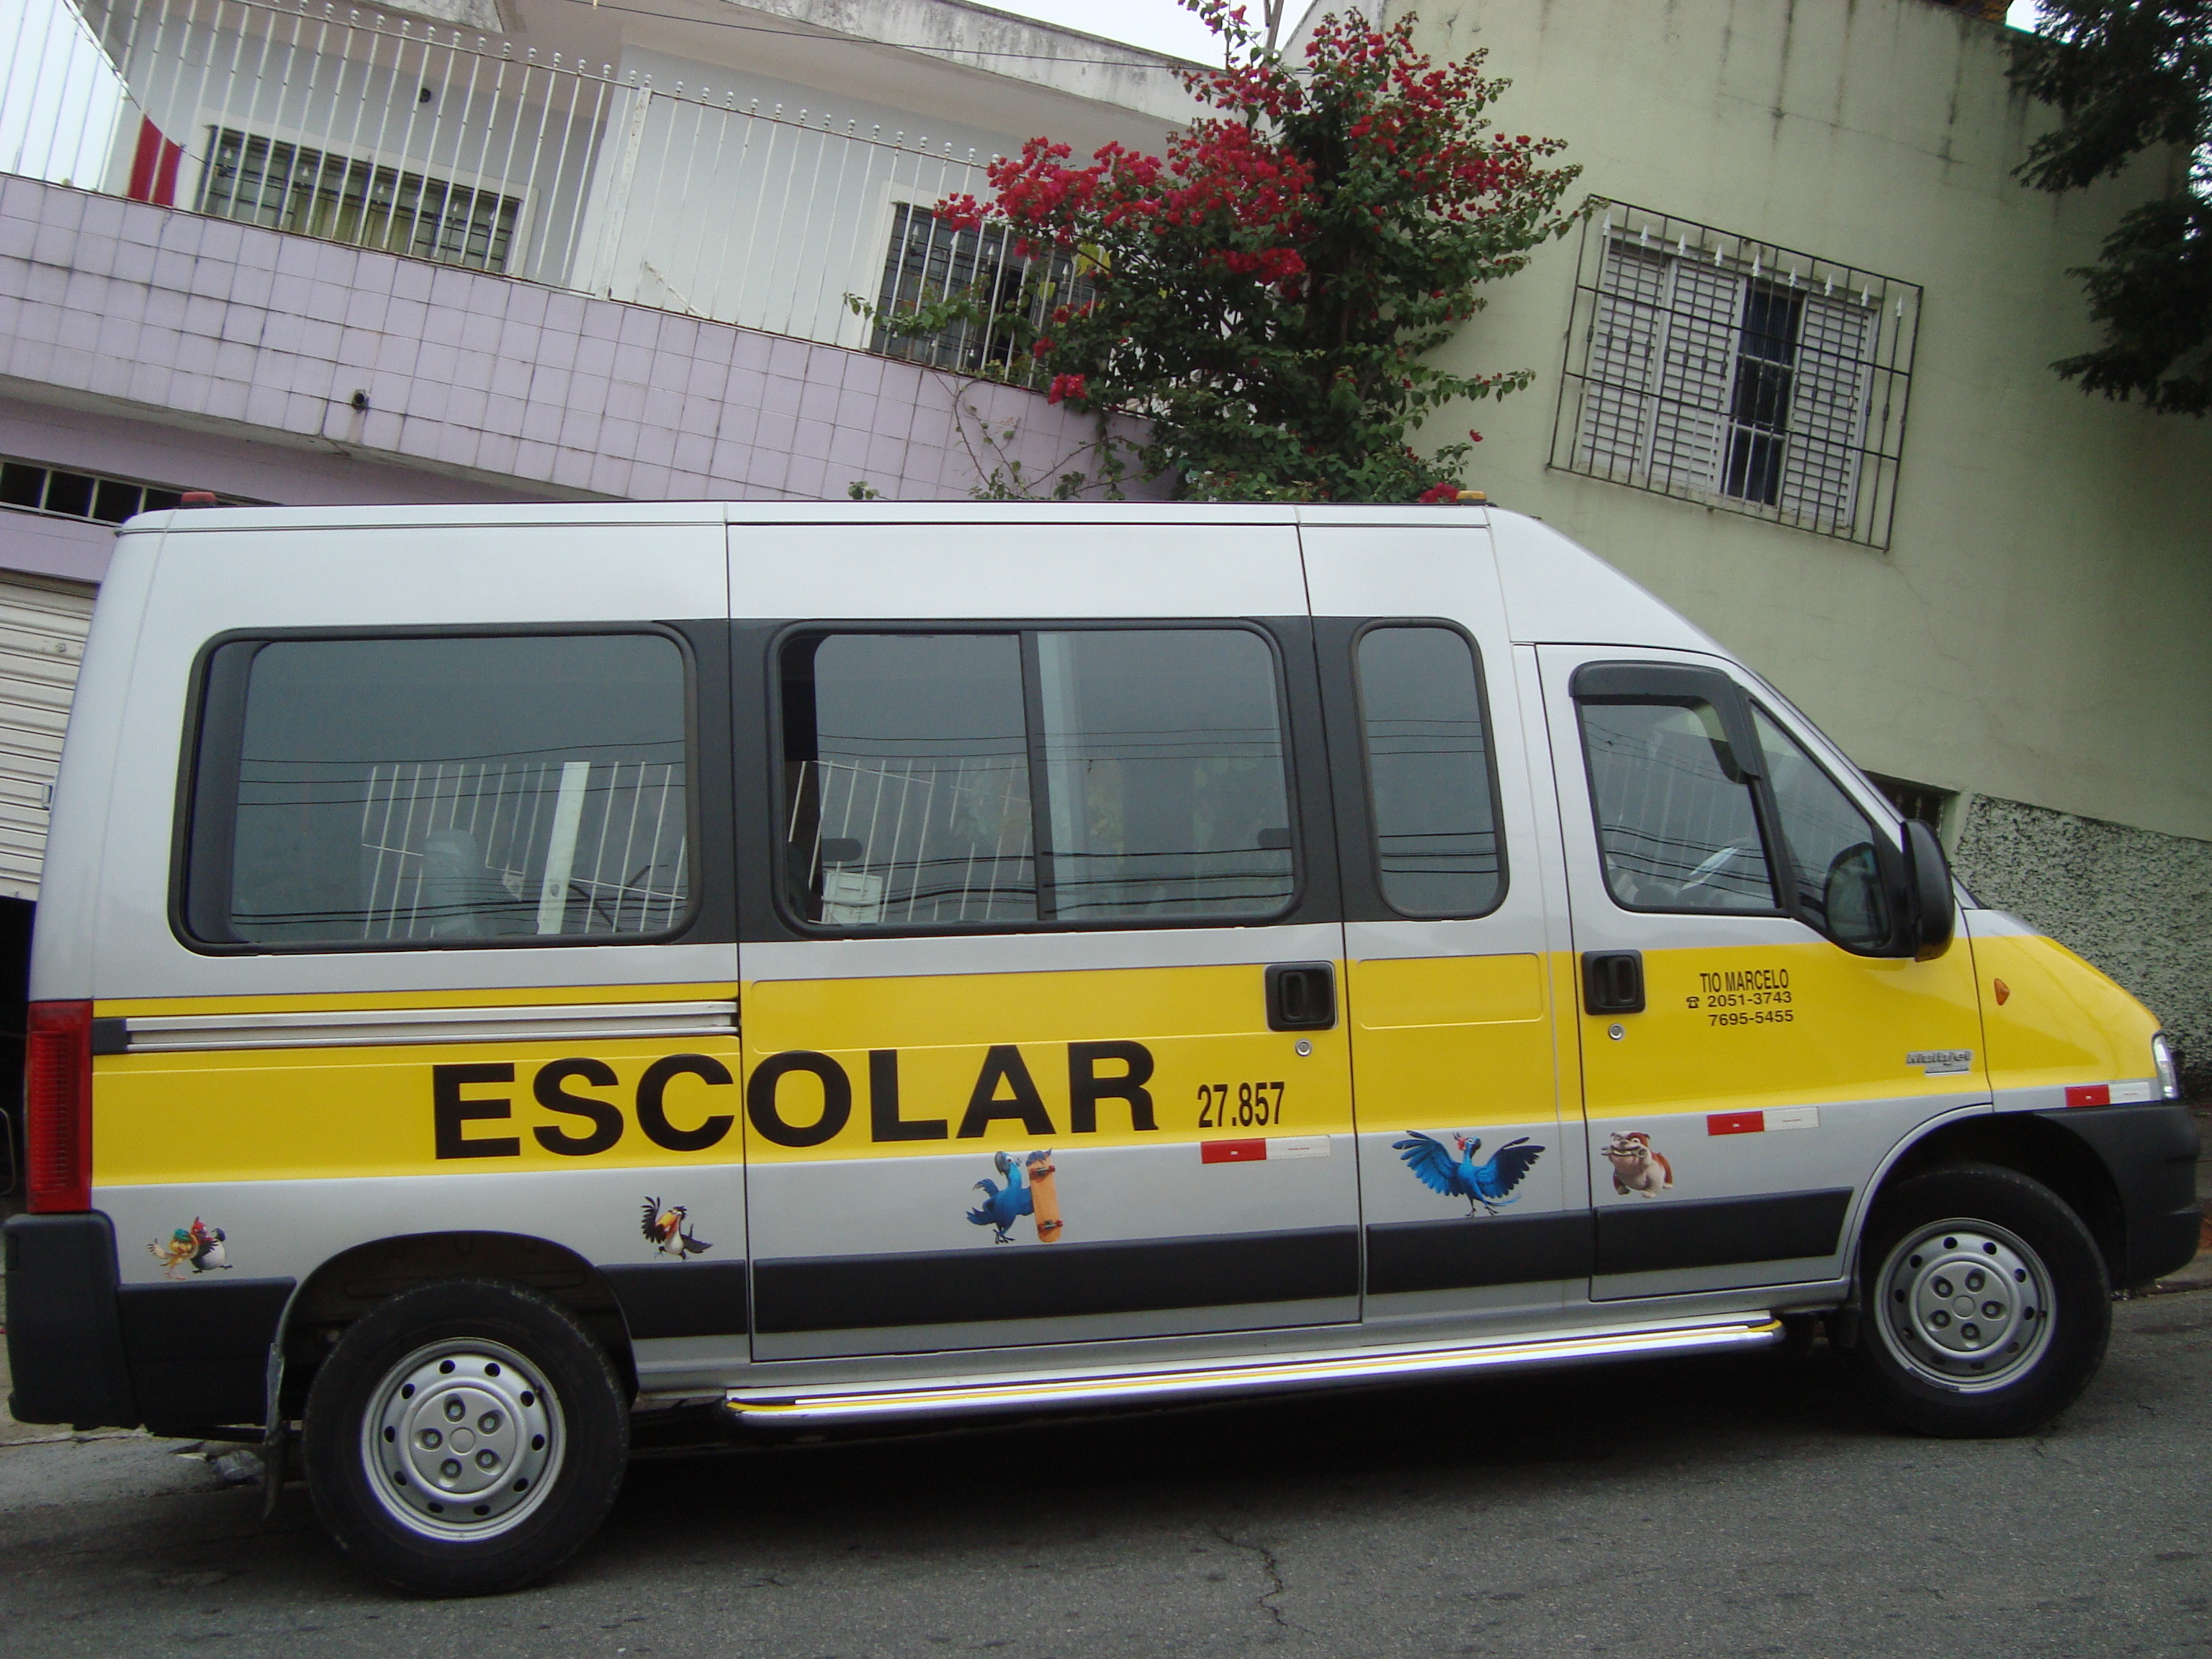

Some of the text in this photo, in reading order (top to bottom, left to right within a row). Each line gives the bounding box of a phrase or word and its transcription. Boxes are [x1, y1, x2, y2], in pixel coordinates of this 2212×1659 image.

[1699, 968, 1789, 993] TIO MARCELO
[1707, 991, 1792, 1007] 2051-3743
[1708, 1010, 1794, 1026] 7695-5455
[433, 1040, 1159, 1159] ESCOLAR
[1197, 1081, 1285, 1128] 27.857
